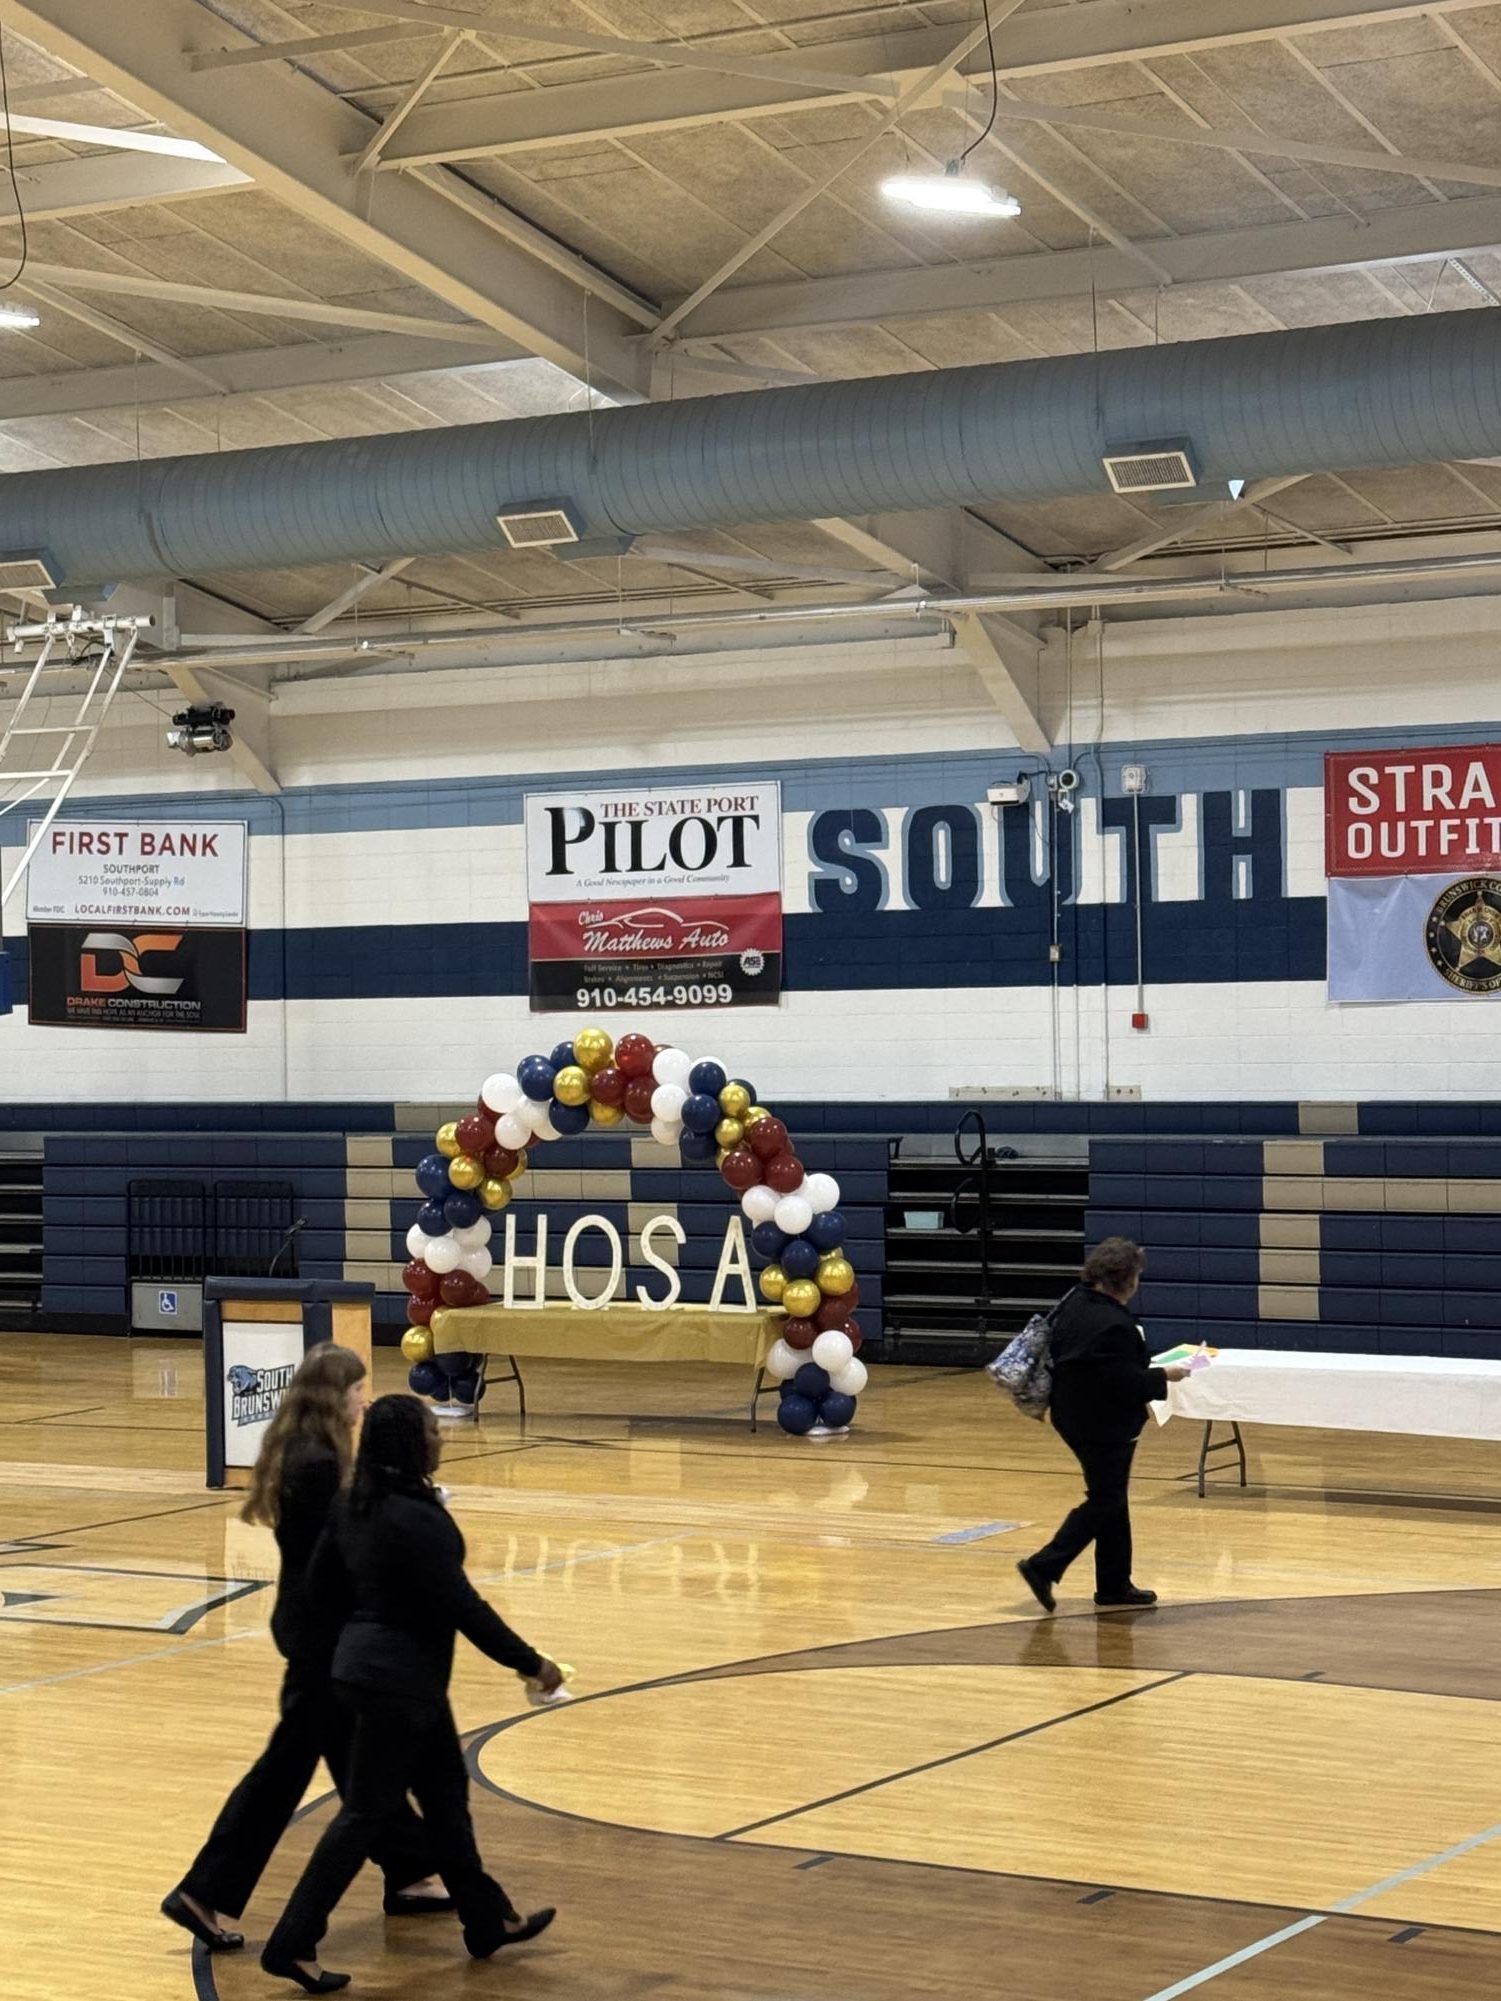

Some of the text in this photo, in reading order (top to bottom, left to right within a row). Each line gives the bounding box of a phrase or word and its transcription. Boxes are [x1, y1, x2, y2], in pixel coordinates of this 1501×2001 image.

[1348, 762, 1496, 815] STRA
[600, 796, 759, 818] THE STATE PORT
[52, 832, 219, 857] FIRST BANK
[544, 806, 760, 876] PILOT
[807, 789, 1287, 912] SOUTH
[103, 864, 160, 874] SOUTHPORT
[576, 879, 582, 887] A
[584, 878, 604, 887] Good
[606, 877, 647, 888] Newspaper
[647, 876, 655, 884] in
[663, 875, 685, 884] Good
[686, 874, 730, 884] Community
[78, 876, 185, 888] 5210 Southport-Supply Rd
[102, 887, 159, 896] 910-457-0804
[1436, 881, 1488, 913] BRUNSWICK
[53, 906, 65, 914] FDIC
[74, 904, 190, 916] LOCALFIRSTBANK.COM
[578, 910, 604, 925] Chris
[582, 927, 729, 952] Matthews Auto
[81, 933, 184, 994] DC
[66, 997, 201, 1010] DRAKE CONSTRUCTION
[577, 984, 732, 1008] 910-454-9099
[503, 1213, 757, 1313] HOSA
[256, 1366, 294, 1392] SOUTH
